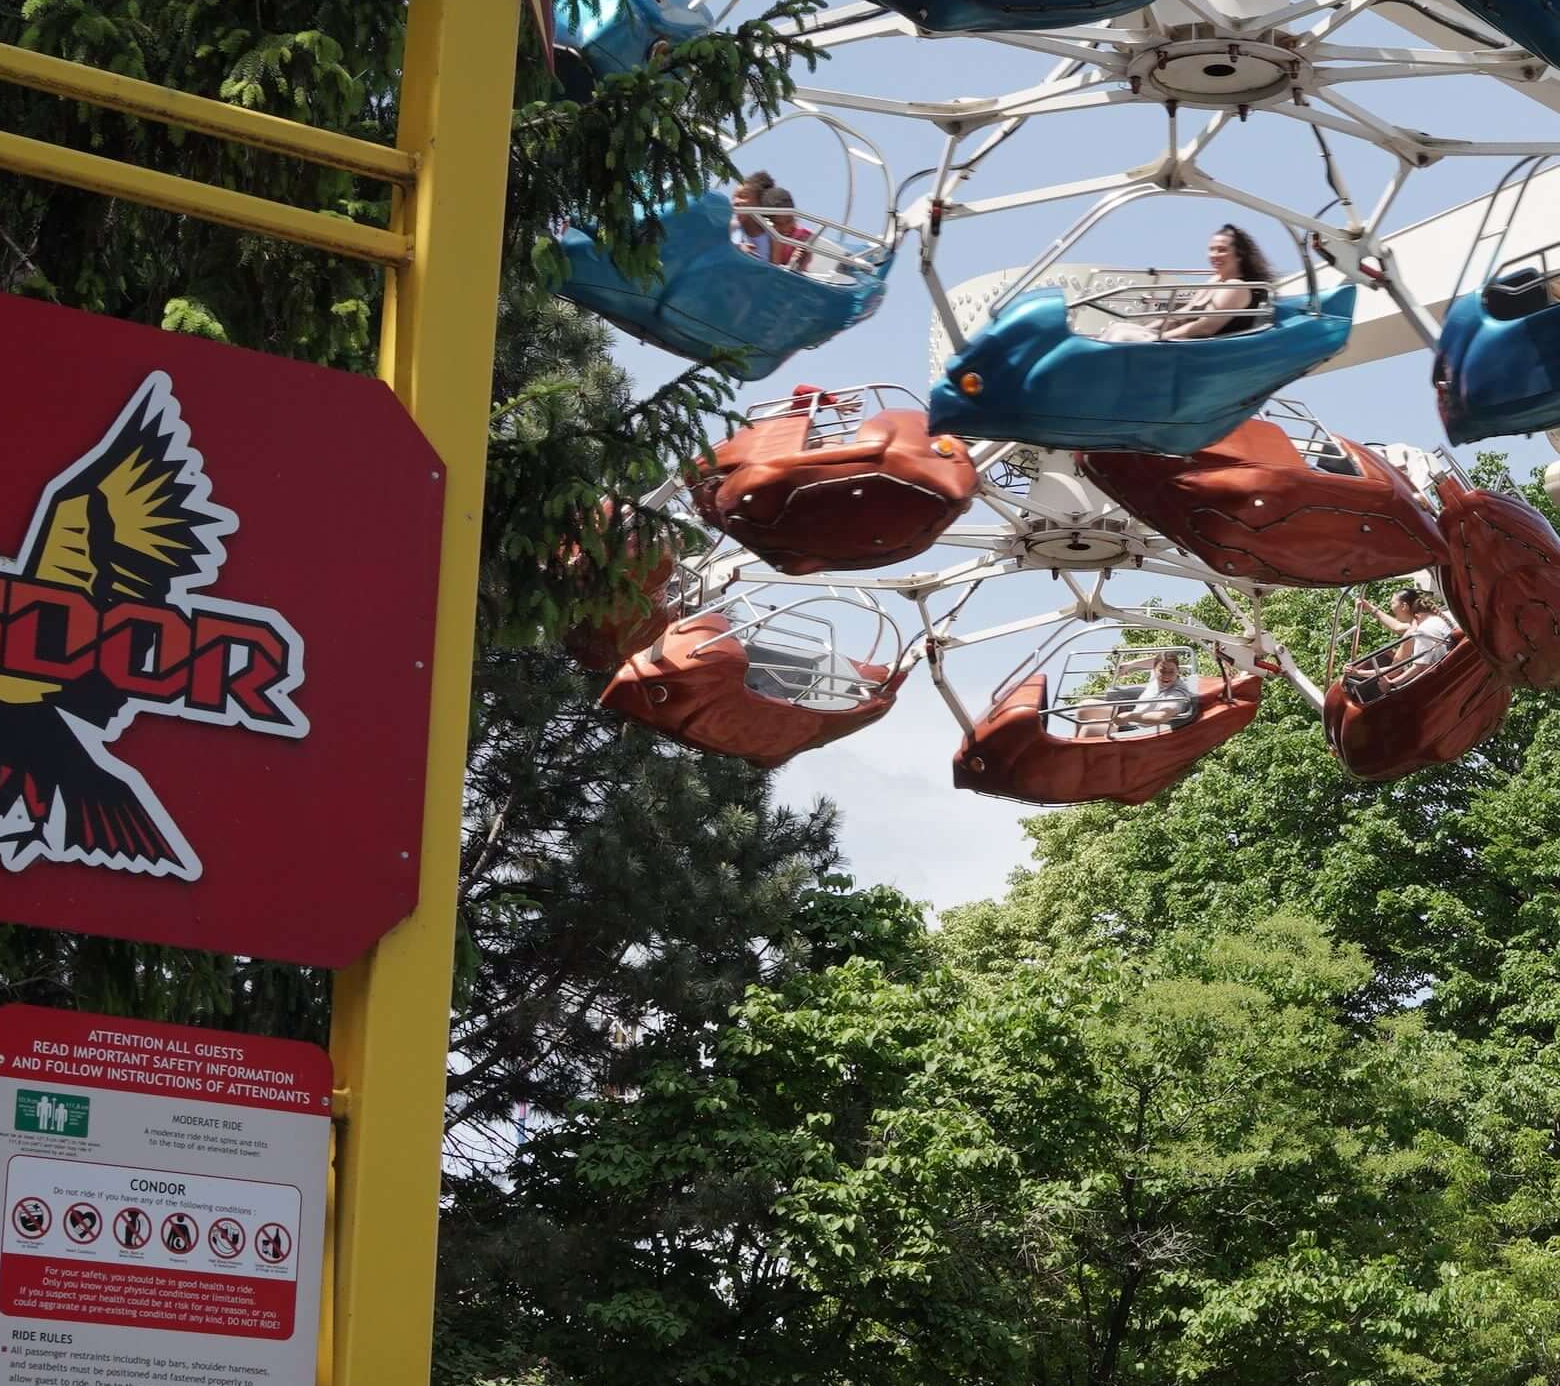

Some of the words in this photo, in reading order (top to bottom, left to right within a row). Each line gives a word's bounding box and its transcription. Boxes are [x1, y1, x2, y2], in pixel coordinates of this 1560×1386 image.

[87, 1030, 164, 1051] ATTENTION
[166, 1039, 191, 1054] ALL
[194, 1043, 244, 1061] GUESTS
[33, 1040, 69, 1056] READ
[73, 1045, 151, 1067] IMPORTANT
[152, 1055, 203, 1074] SAFETY
[206, 1062, 294, 1086] INFORMATION
[11, 1055, 41, 1071] AND
[45, 1059, 104, 1078] FOLLOW
[107, 1066, 202, 1091] INSTRUCTIONS
[206, 1079, 225, 1093] OF
[226, 1082, 310, 1105] ATTENDANTS
[172, 1115, 220, 1129] MODERATE
[222, 1120, 243, 1132] RIDE
[130, 1178, 186, 1196] CONDOR
[11, 1329, 37, 1342] RIDE
[39, 1332, 73, 1345] RULES
